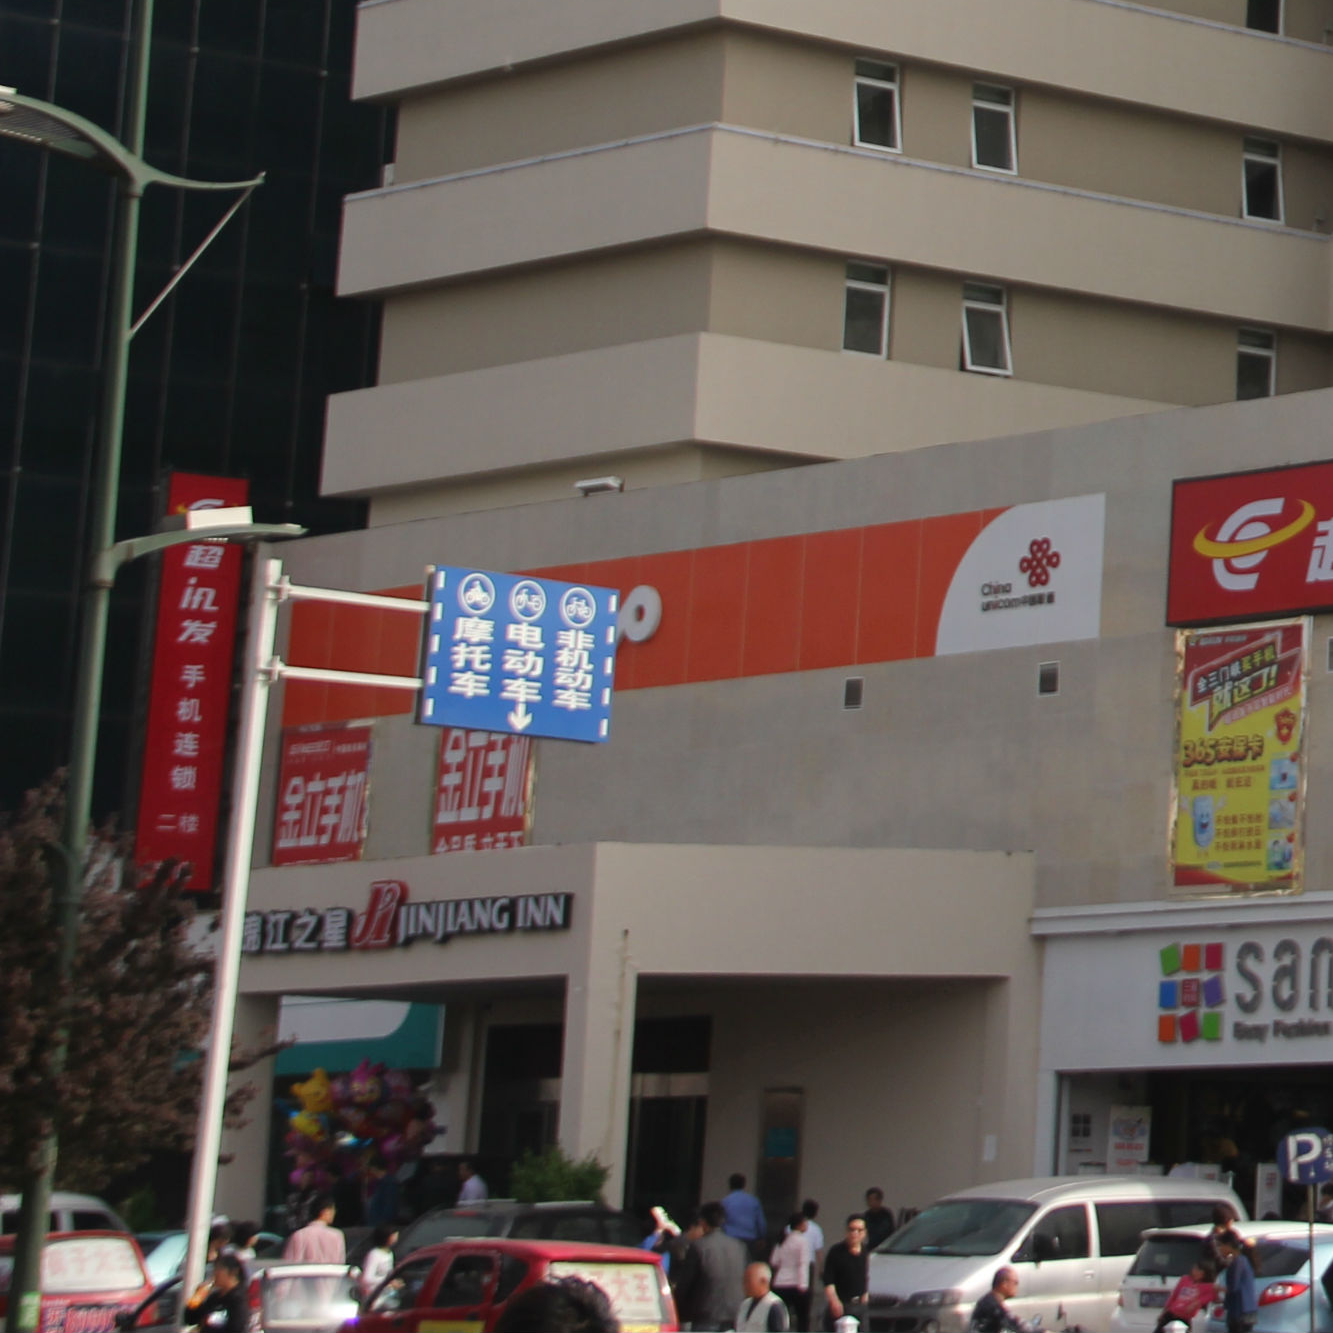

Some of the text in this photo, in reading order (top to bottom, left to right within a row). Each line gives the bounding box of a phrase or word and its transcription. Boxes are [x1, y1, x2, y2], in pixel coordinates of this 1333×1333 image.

[448, 616, 495, 698] 摩托车
[499, 622, 545, 702] 电动车
[552, 629, 596, 711] 非机动车
[171, 664, 206, 790] 手机连锁
[156, 812, 201, 834] 二楼
[277, 768, 367, 849] 金立手机
[399, 893, 570, 944] JINJIANG INN
[1287, 1133, 1322, 1182] P
